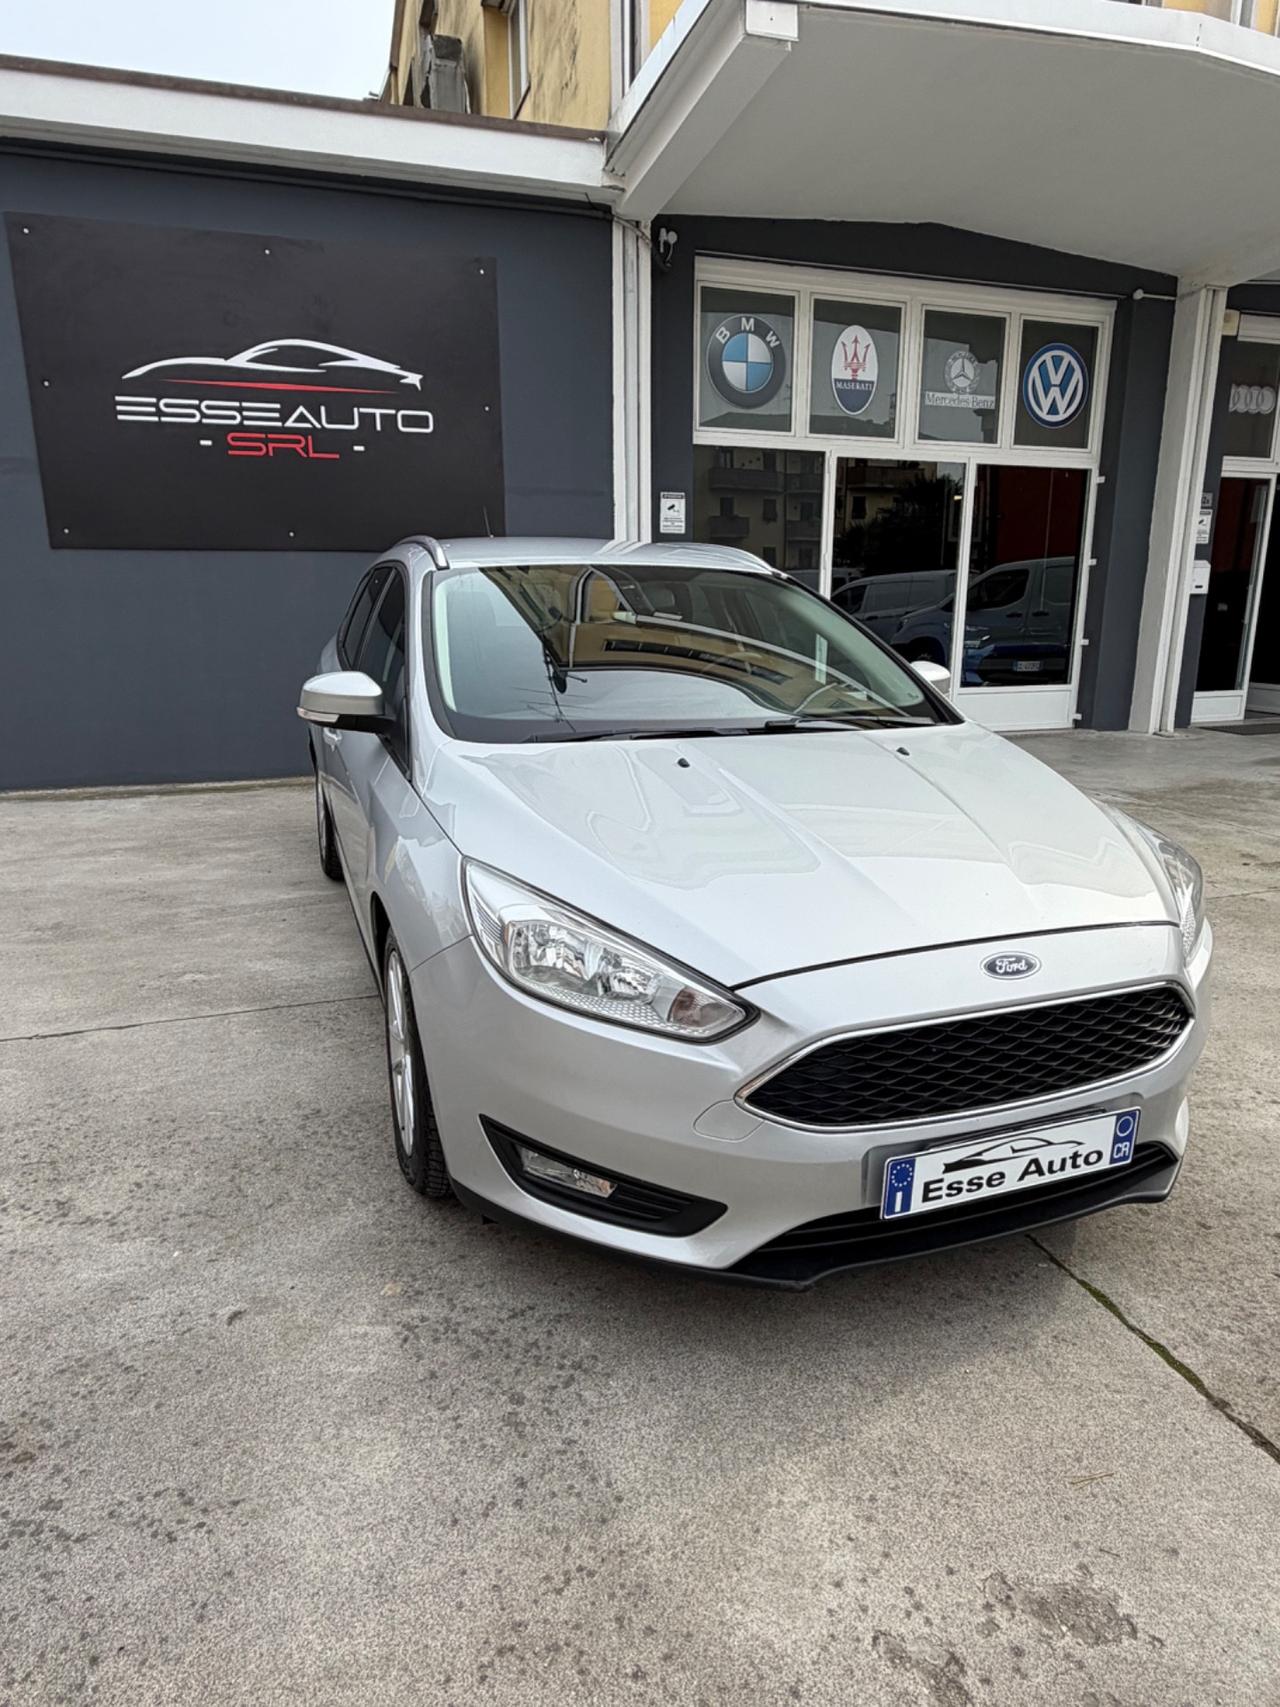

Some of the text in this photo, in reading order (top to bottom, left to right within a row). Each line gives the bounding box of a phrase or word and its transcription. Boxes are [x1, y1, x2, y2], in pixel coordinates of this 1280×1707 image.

[715, 317, 781, 348] BMW
[836, 381, 872, 391] MASERATI
[227, 432, 340, 459] SRL
[995, 957, 1028, 973] Ford
[922, 1149, 1103, 1203] Esse Auto
